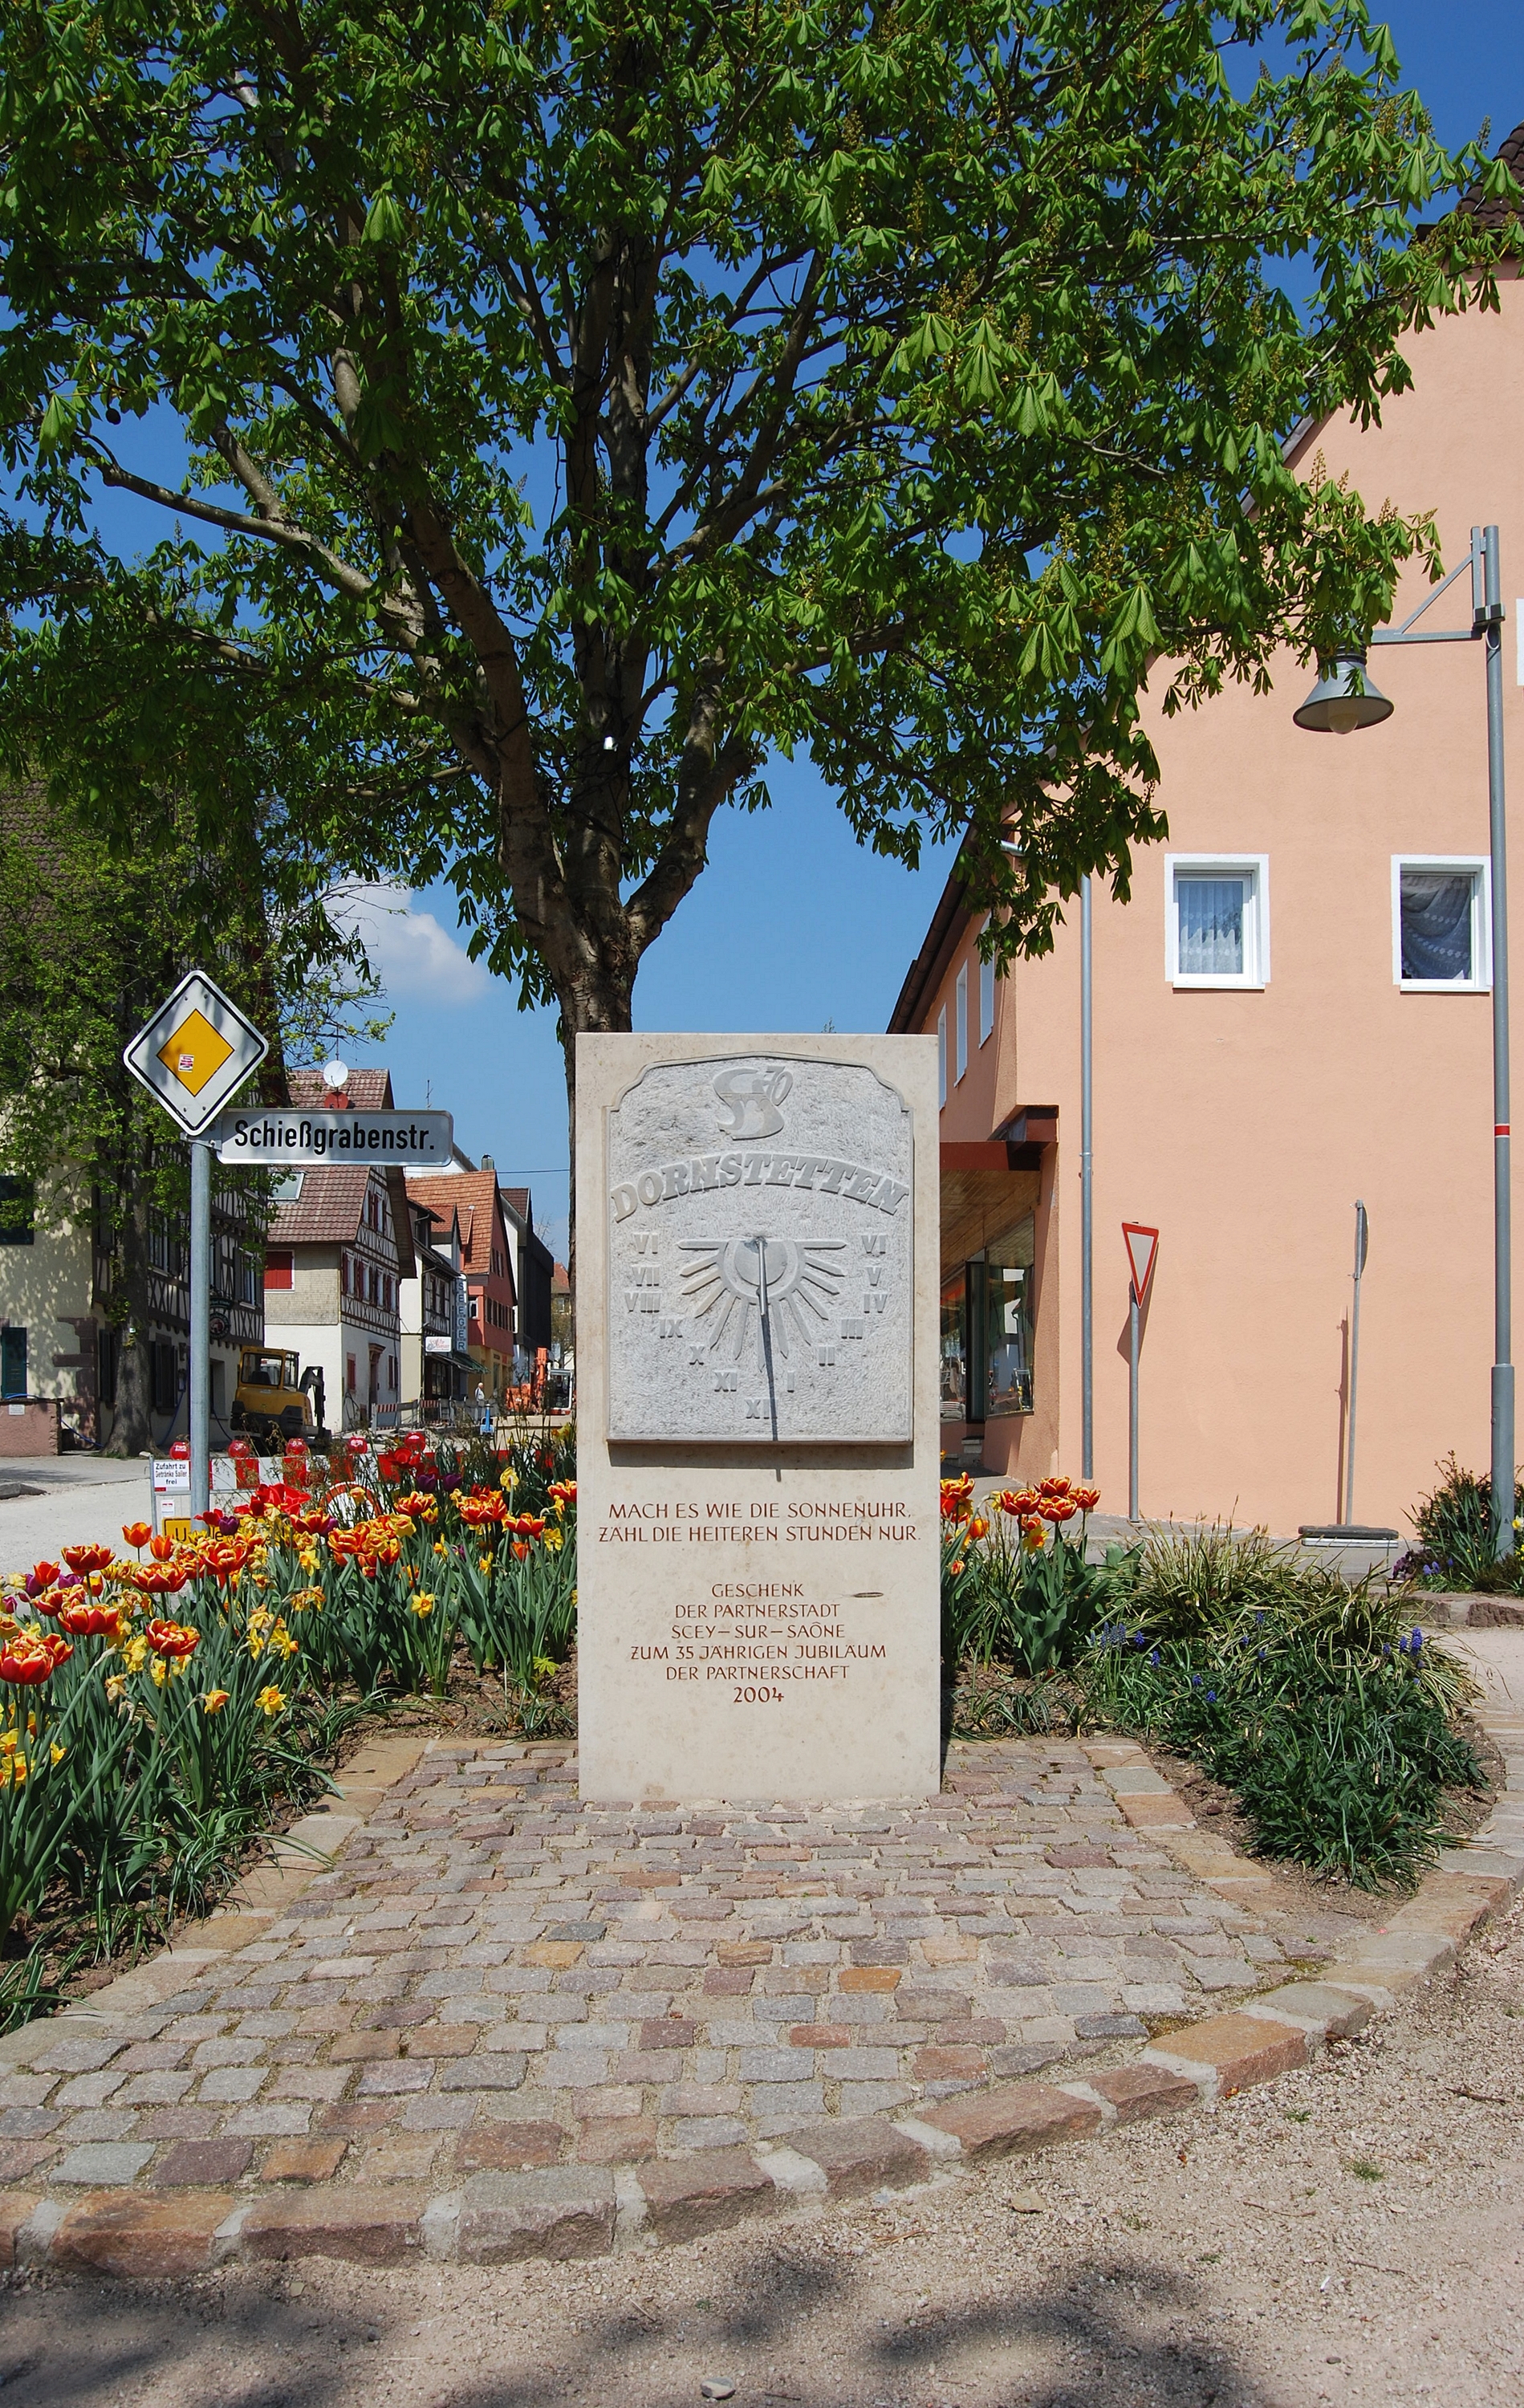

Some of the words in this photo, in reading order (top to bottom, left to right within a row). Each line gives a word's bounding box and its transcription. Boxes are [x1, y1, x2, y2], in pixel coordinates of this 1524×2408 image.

[234, 1119, 435, 1156] Schießgrabenstr.
[610, 1152, 910, 1223] DORNSTETTEN
[632, 1232, 659, 1254] VI
[860, 1234, 886, 1254] VI
[631, 1265, 660, 1287] VII
[867, 1267, 882, 1287] V
[624, 1291, 660, 1313] VIII
[864, 1292, 888, 1313] IV
[457, 1282, 465, 1351] SEEGER
[659, 1318, 684, 1339] IX
[841, 1318, 864, 1339] III
[689, 1345, 705, 1365] X
[819, 1345, 835, 1366] II
[714, 1371, 738, 1393] XI
[156, 1462, 177, 1470] Zufahrt
[608, 1503, 668, 1519] MACH
[676, 1503, 698, 1519] ES
[705, 1503, 742, 1519] WIE
[750, 1503, 779, 1519] DIE
[599, 1526, 648, 1543] ZÄHL
[652, 1527, 682, 1543] DIE
[689, 1526, 778, 1542] HEITEREN
[786, 1525, 872, 1542] STUNDEN
[711, 1583, 804, 1598] GESCHENK
[675, 1605, 707, 1619] DER
[714, 1604, 841, 1618] PARTNERSTADT
[631, 1646, 669, 1661] ZUM
[675, 1645, 694, 1660] 35
[698, 1645, 788, 1660] JÄHRIGEN
[795, 1645, 887, 1660] JUBILÄUM
[666, 1666, 699, 1681] DER
[706, 1666, 850, 1681] PARTNERSCHAFT
[733, 1686, 785, 1703] 2004
